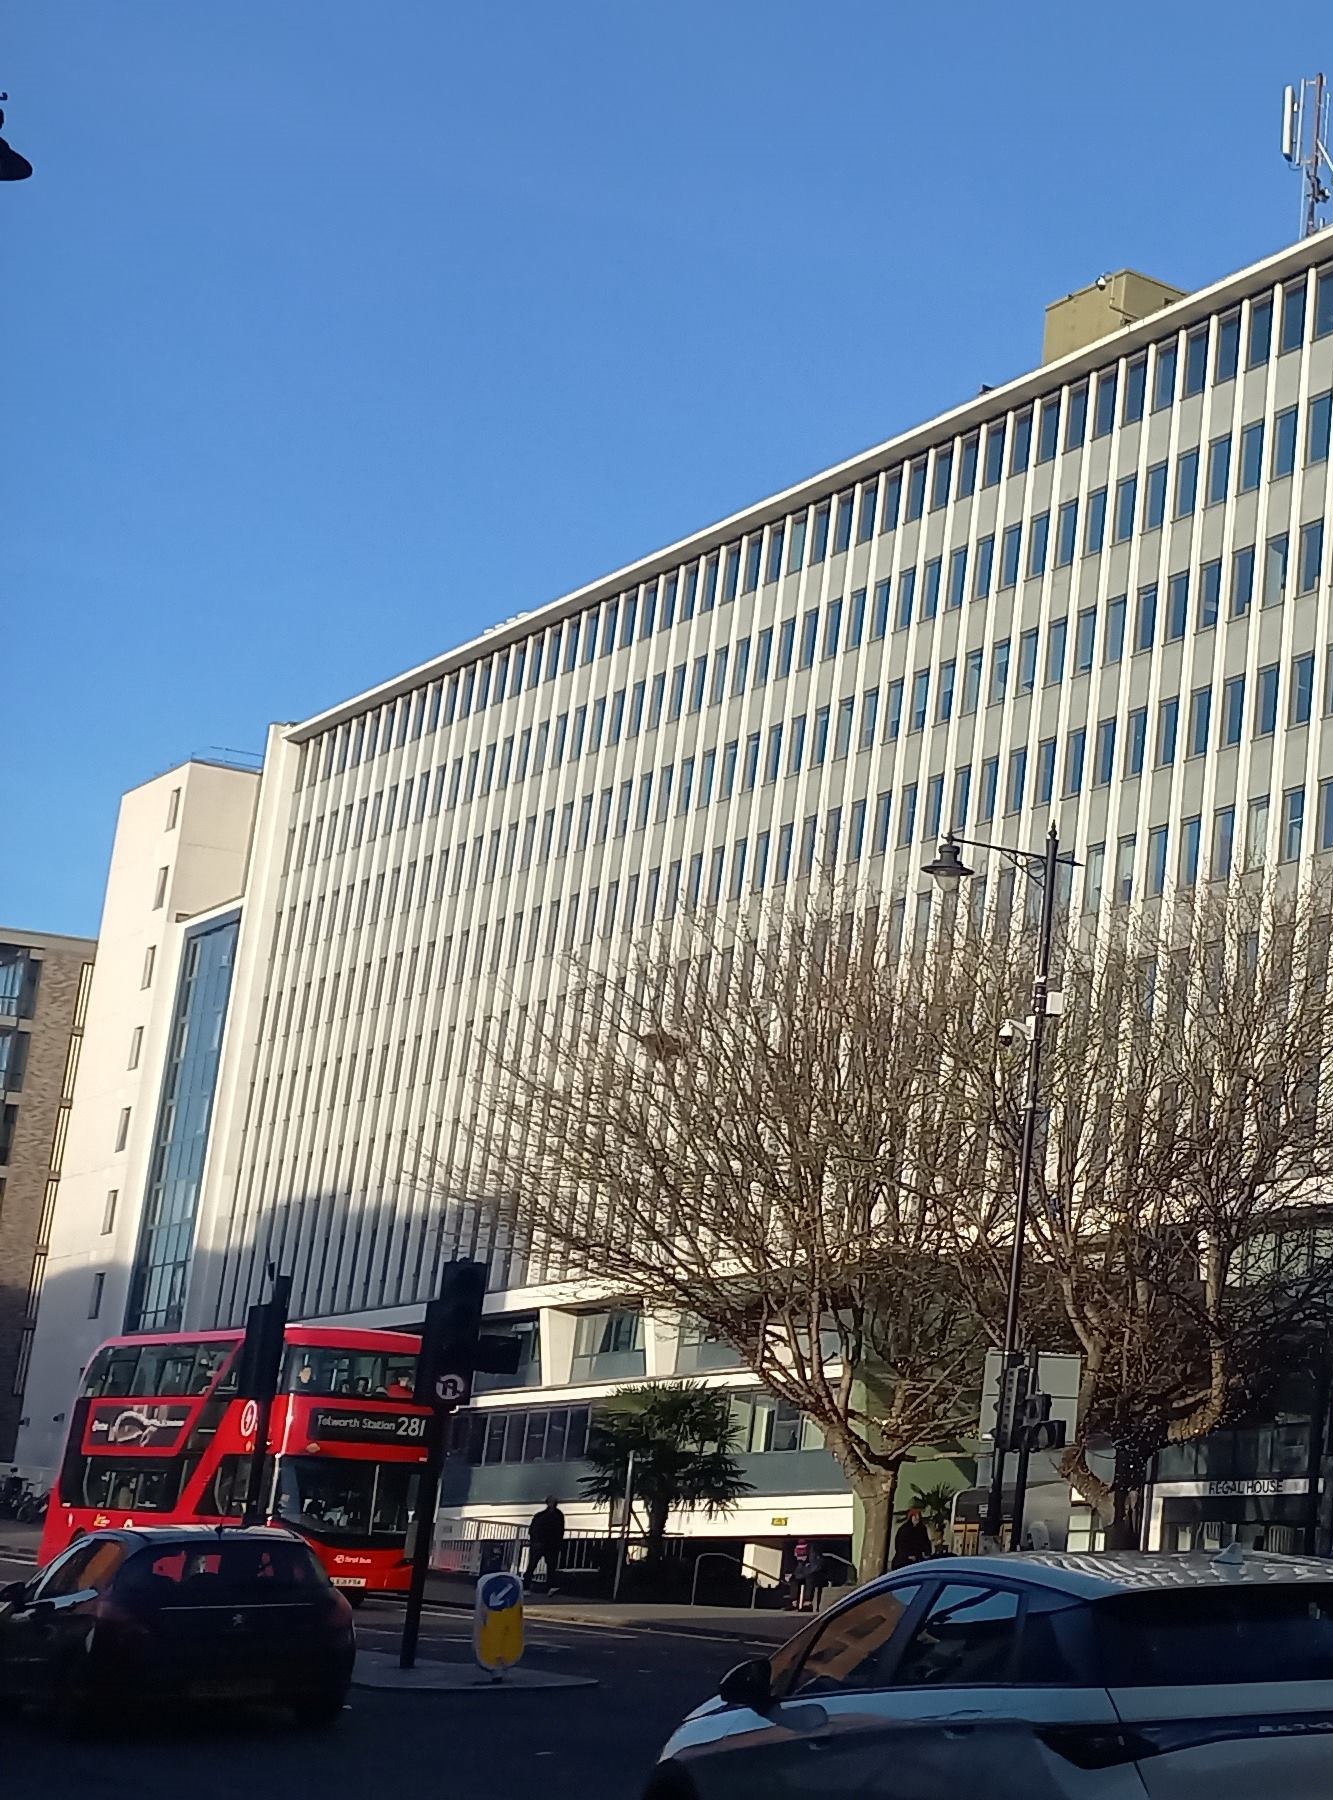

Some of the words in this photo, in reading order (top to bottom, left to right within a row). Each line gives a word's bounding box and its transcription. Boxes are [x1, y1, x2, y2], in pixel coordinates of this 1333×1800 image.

[317, 1414, 360, 1429] Tolworth
[362, 1418, 396, 1430] Station
[396, 1416, 427, 1437] 281
[1208, 1480, 1245, 1495] REGAL
[1246, 1479, 1284, 1494] HOUSE
